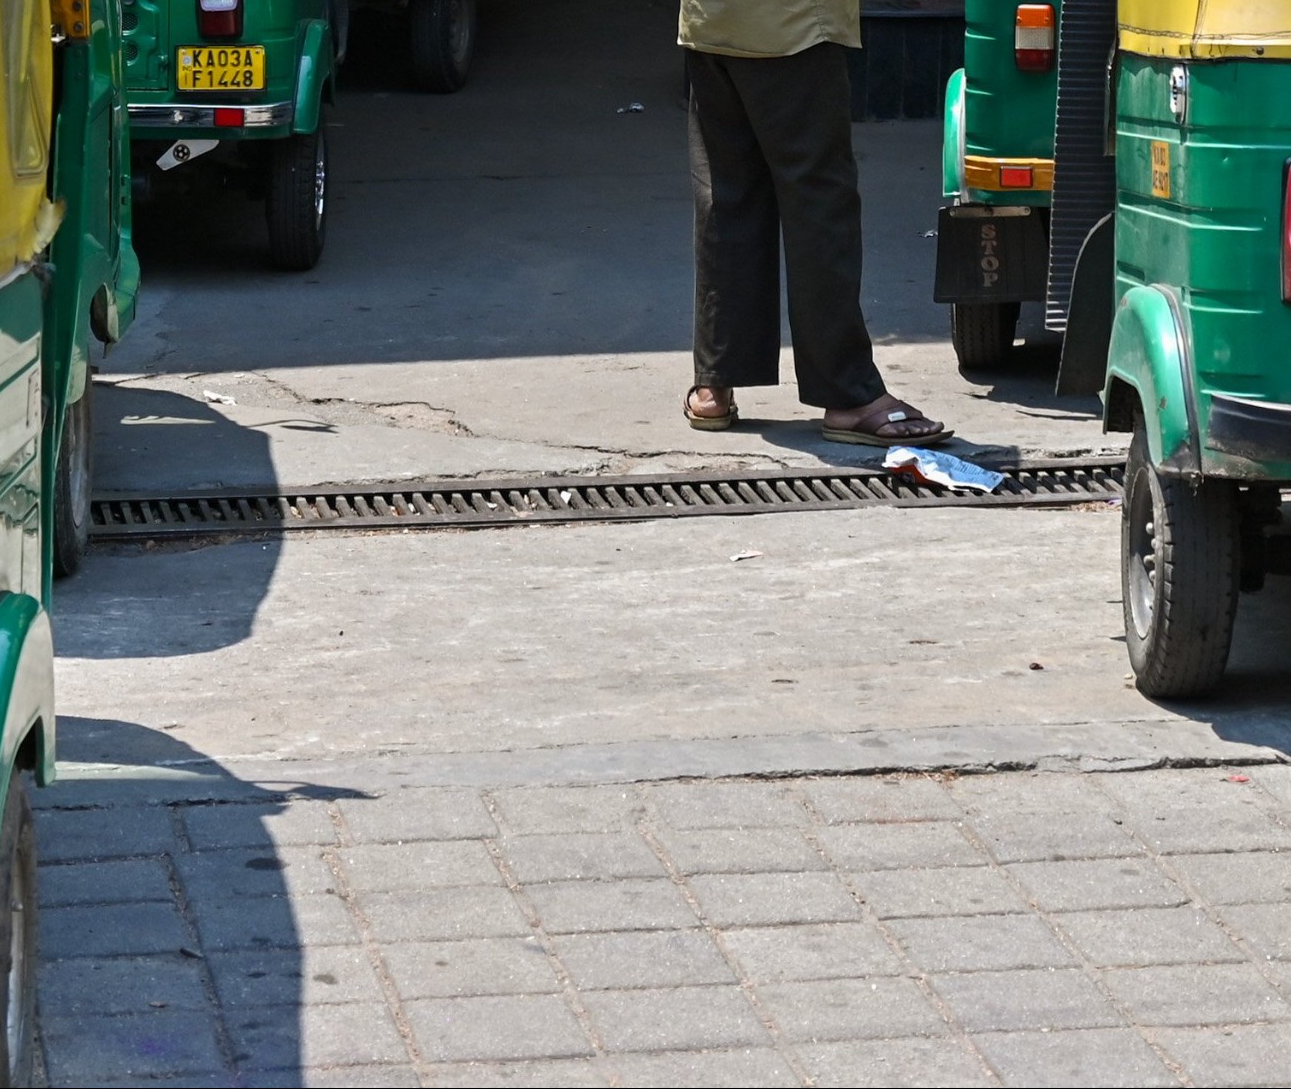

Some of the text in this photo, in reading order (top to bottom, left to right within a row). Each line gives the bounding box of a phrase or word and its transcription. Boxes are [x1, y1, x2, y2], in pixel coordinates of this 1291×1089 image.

[193, 50, 253, 68] KA03A
[193, 70, 253, 88] F1448
[981, 223, 999, 288] STOP
